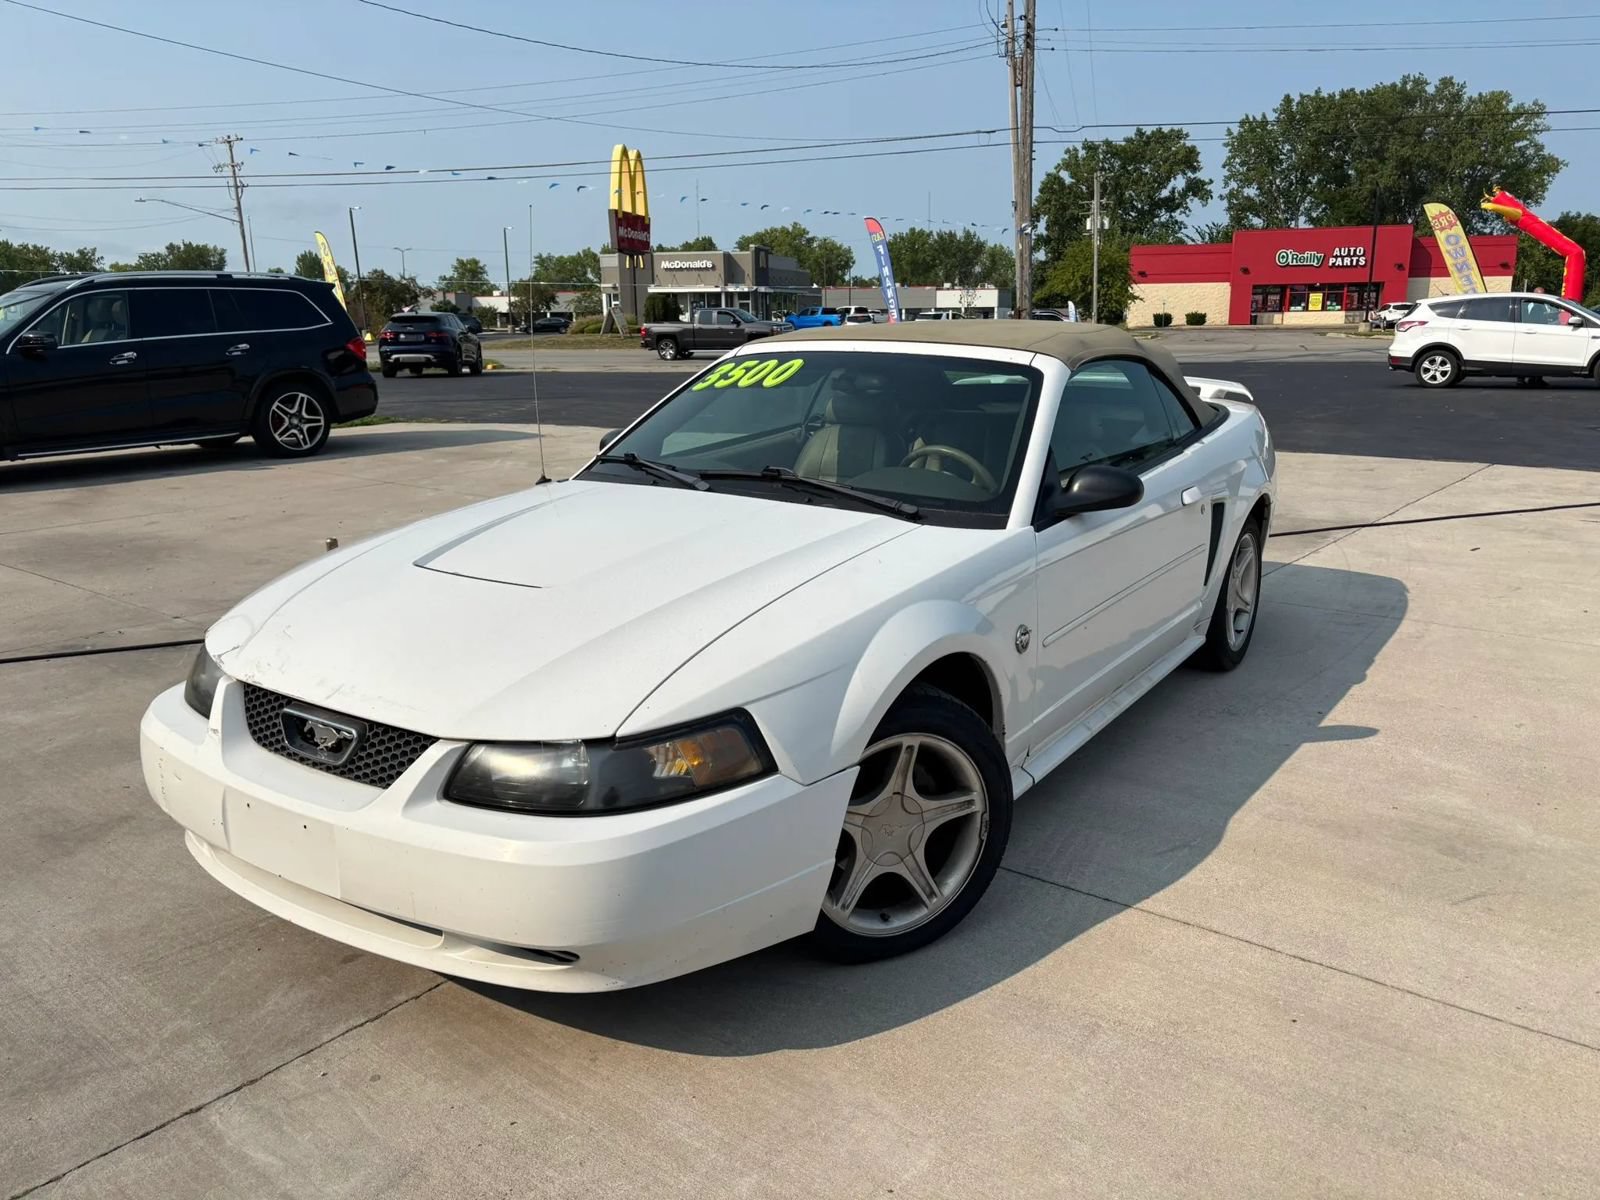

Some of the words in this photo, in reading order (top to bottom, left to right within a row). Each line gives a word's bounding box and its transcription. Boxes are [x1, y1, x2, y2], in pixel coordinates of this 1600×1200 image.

[618, 226, 650, 242] McDonald's
[660, 259, 713, 269] McDonald's
[1276, 249, 1324, 266] O'Reilly
[1333, 246, 1364, 256] AUTO
[1328, 256, 1366, 267] PARTS
[691, 358, 805, 391] 3500
